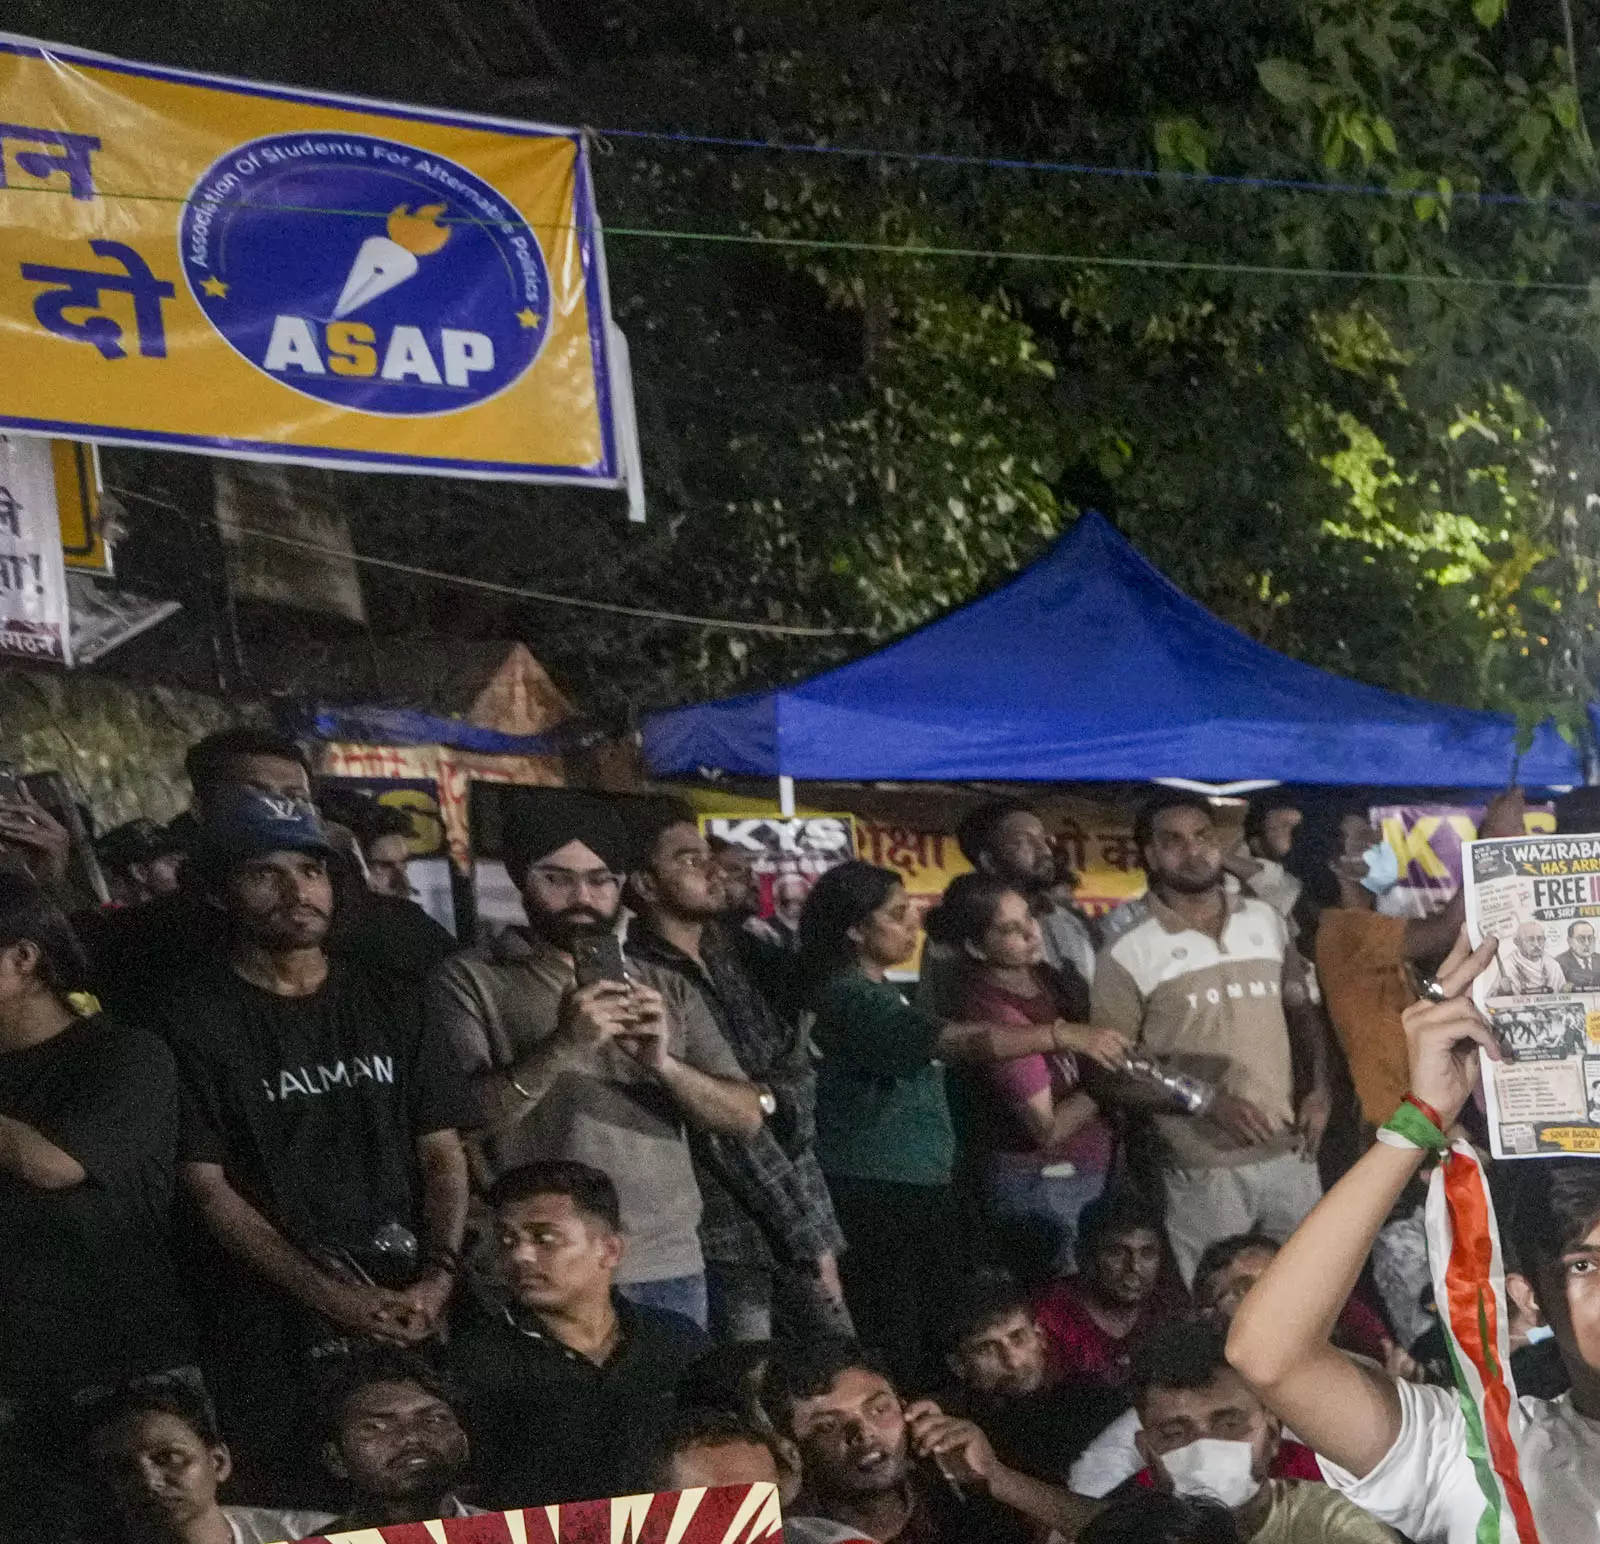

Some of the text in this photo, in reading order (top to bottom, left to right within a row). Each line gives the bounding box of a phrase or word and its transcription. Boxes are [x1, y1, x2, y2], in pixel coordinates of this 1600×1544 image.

[239, 155, 261, 175] Of
[261, 138, 367, 165] Students
[373, 145, 411, 169] For
[18, 237, 176, 361] दो
[263, 314, 496, 388] ASAP
[712, 817, 848, 854] KYS
[1541, 861, 1568, 875] HAS
[1533, 876, 1587, 907] FREE
[1579, 906, 1600, 917] FREE
